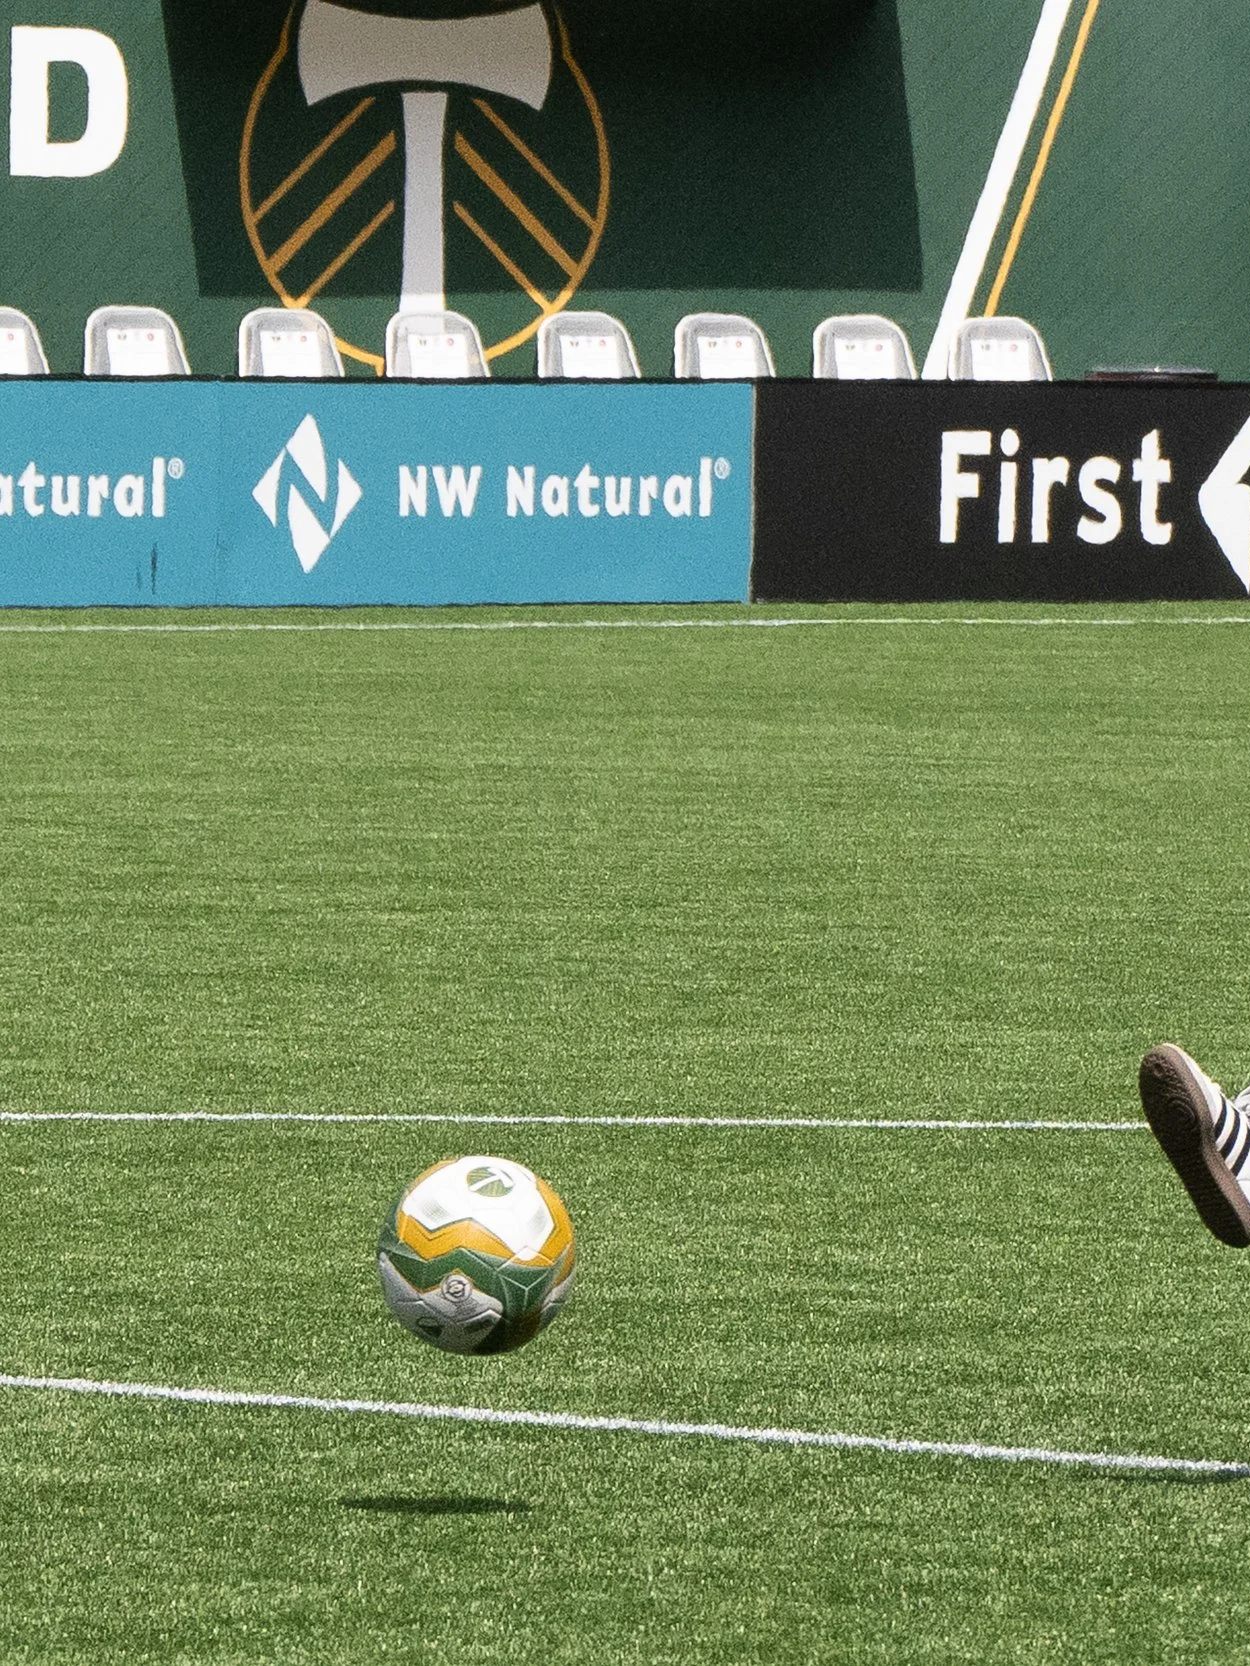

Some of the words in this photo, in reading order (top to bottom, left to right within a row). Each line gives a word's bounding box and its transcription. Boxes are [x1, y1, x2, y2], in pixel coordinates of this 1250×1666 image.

[10, 26, 127, 177] D
[398, 465, 482, 517] NW
[940, 429, 1172, 545] First
